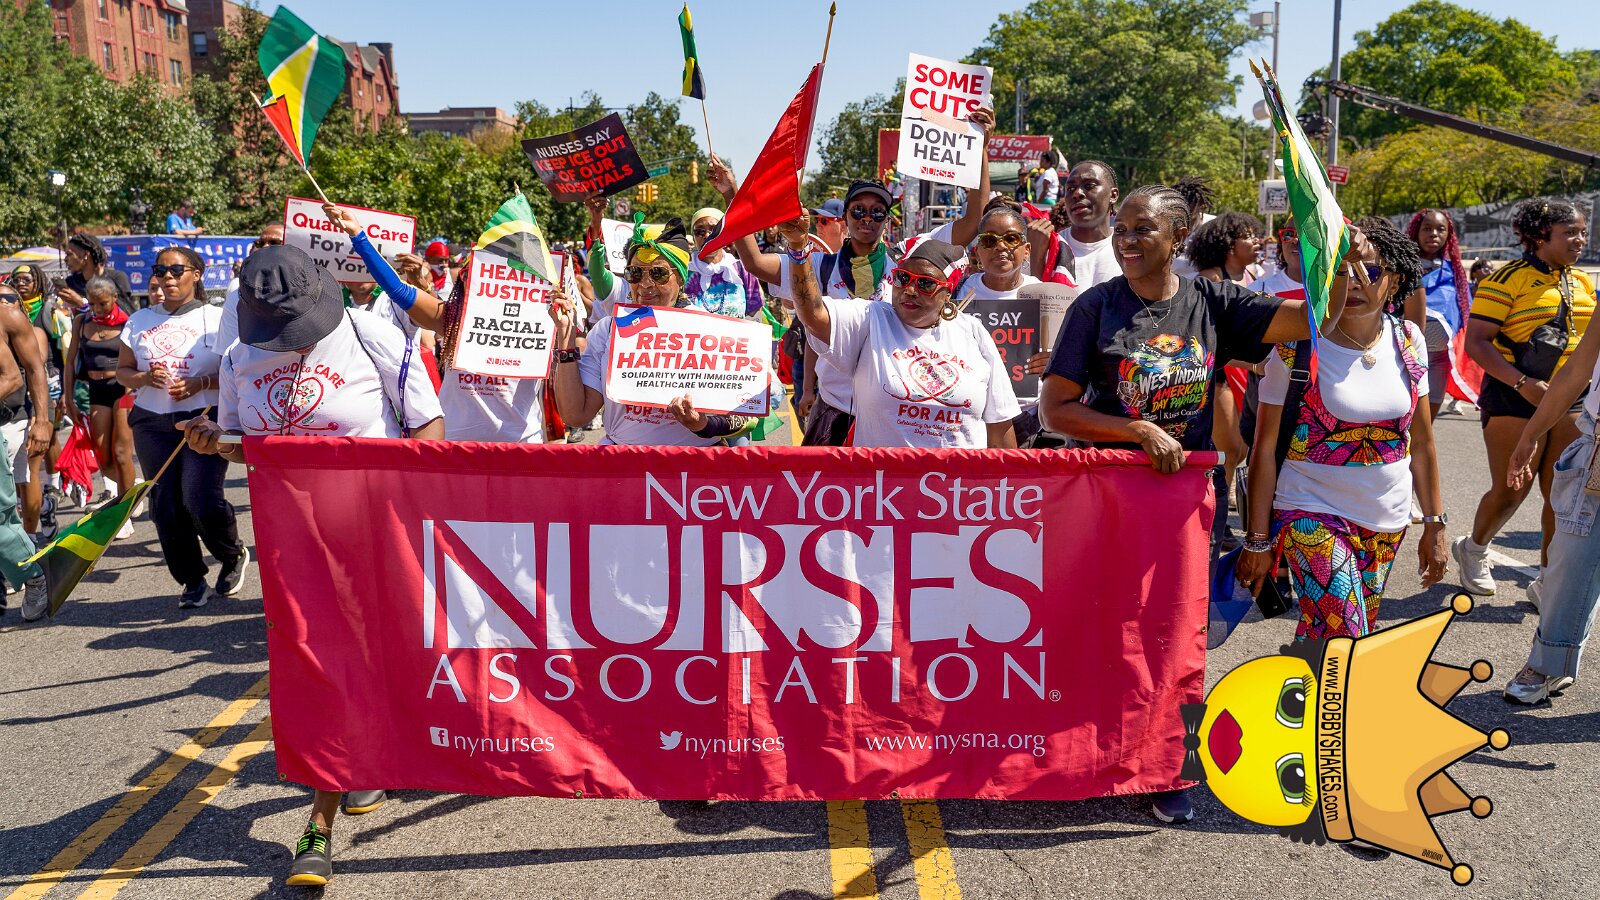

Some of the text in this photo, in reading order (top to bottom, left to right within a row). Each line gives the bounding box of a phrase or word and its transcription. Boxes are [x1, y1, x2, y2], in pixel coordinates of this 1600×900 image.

[914, 63, 985, 95] SOME
[910, 87, 981, 120] CUTS
[536, 126, 612, 159] NURSES SAY
[910, 123, 977, 151] DON'T
[1007, 137, 1030, 148] for
[535, 134, 627, 172] KEEP ICE OUT
[913, 142, 966, 167] HEAL
[1000, 147, 1022, 157] for
[555, 163, 634, 194] HOSPITALS
[558, 157, 616, 182] OF OUR
[920, 166, 956, 179] NURSES
[309, 233, 344, 253] For
[367, 223, 409, 243] Care
[476, 282, 551, 304] JUSTICE
[503, 305, 519, 315] IS
[988, 312, 1022, 326] SAY
[472, 316, 545, 335] RACIAL
[465, 332, 547, 350] JUSTICE
[636, 332, 750, 354] RESTORE
[991, 328, 1035, 345] OUT
[171, 360, 190, 370] ALL
[486, 357, 521, 366] NURSES
[616, 352, 764, 373] HAITIAN TPS
[253, 362, 346, 391] PROUD to CARE
[458, 373, 509, 386] FOR ALL
[621, 371, 757, 382] SOLIDARITY WITH IMMIGRANT
[636, 380, 743, 390] HEALTHCARE WORKERS
[1139, 365, 1208, 394] WEST INDIAN
[1152, 381, 1206, 402] AMERICAN
[897, 403, 963, 424] FOR ALL
[1151, 393, 1202, 413] DAY PARADE
[645, 470, 1044, 522] New York State
[422, 519, 1044, 653] NURSES
[454, 732, 556, 757] nynurses
[684, 731, 785, 760] nynurses
[865, 732, 1046, 758] www.nysna.org
